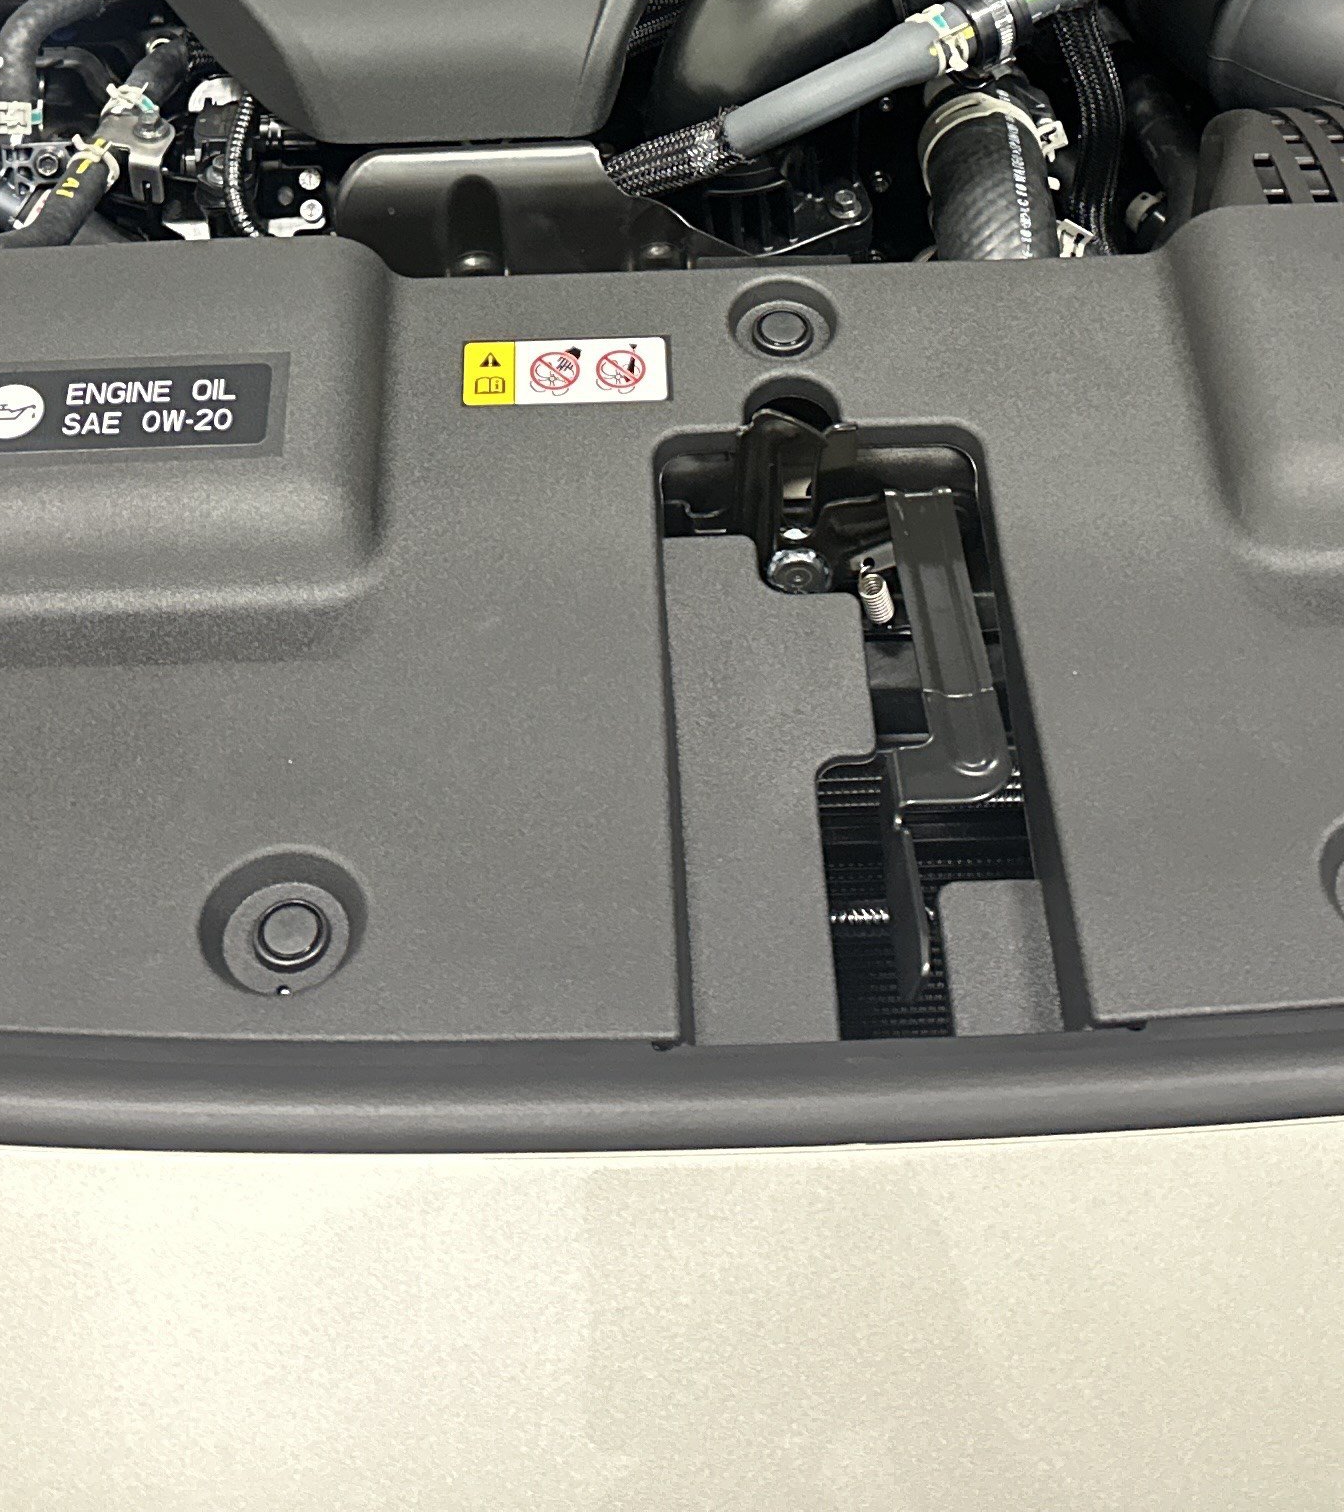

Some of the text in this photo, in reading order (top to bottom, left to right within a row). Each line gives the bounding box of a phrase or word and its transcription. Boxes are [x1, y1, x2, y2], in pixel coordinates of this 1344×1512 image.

[65, 377, 237, 407] ENGINE OIL
[61, 408, 234, 437] SAE 0W-20
